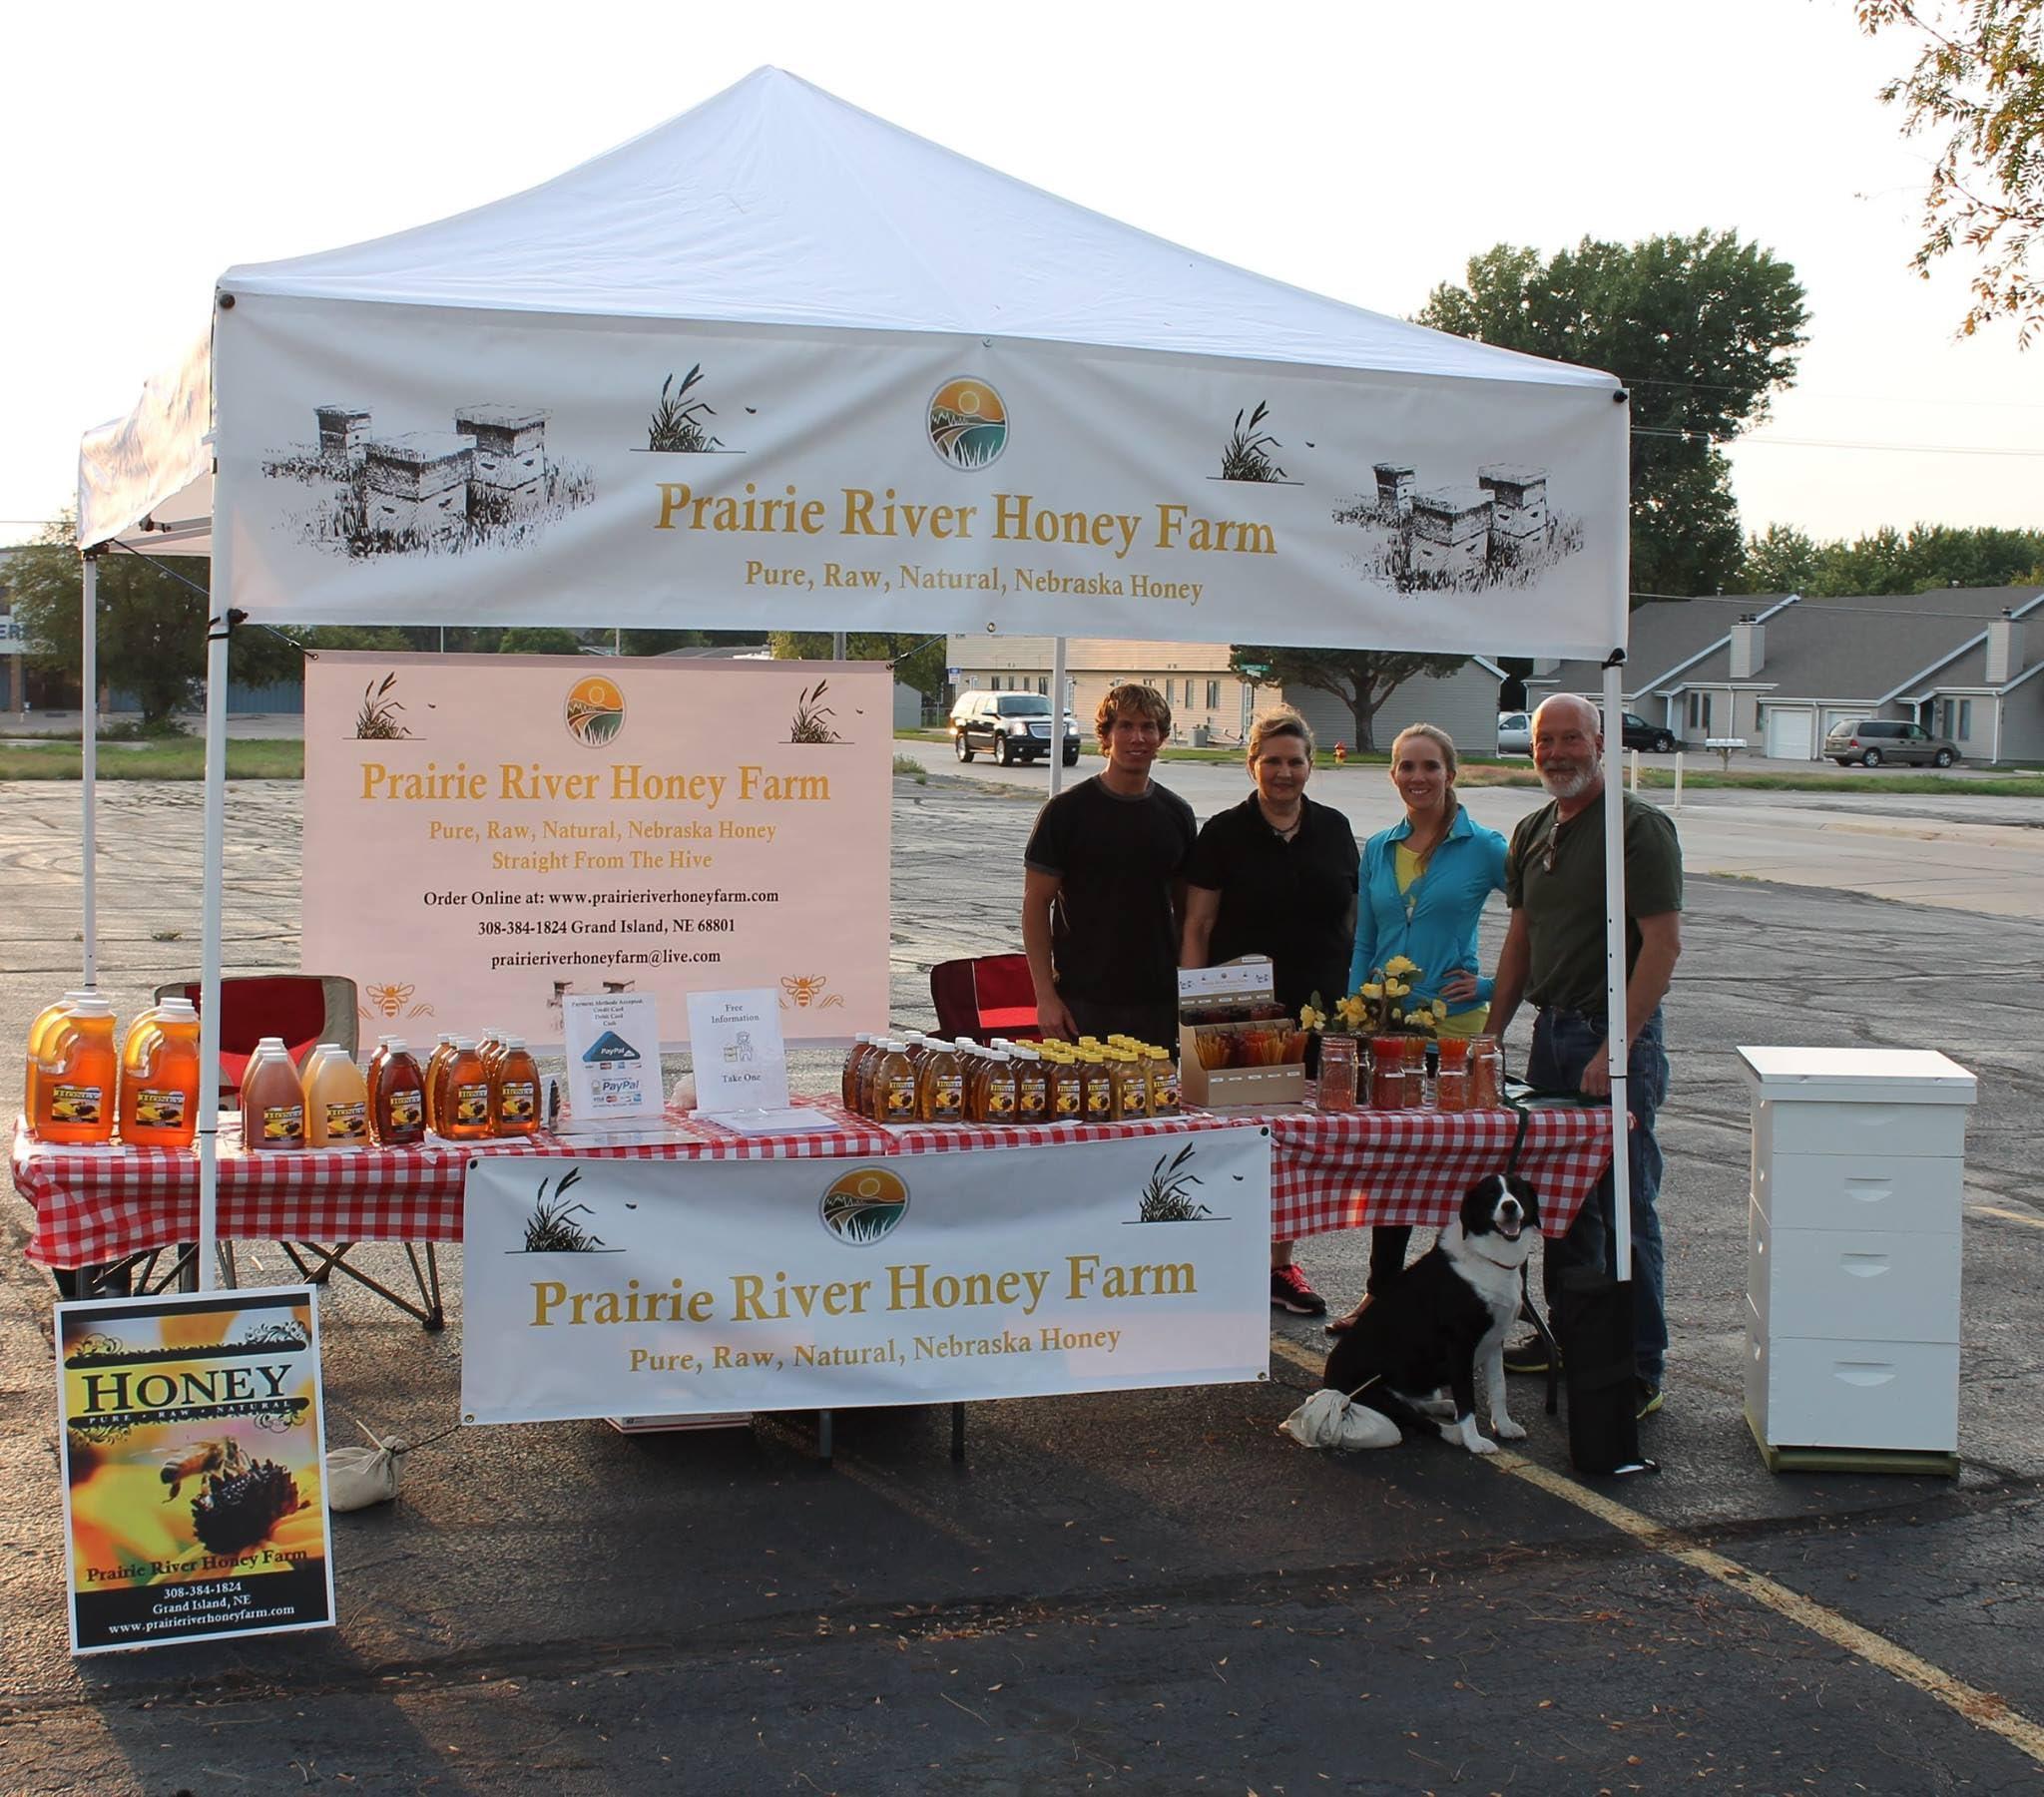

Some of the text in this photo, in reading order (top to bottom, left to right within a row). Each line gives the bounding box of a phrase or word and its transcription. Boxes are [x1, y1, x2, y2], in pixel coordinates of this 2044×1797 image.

[654, 483, 1278, 559] Prairie River Honey Farm
[745, 560, 1204, 606] Pure, Raw, Natural, Nebraska Honey
[360, 763, 831, 809] Prairie River Honey Farm
[429, 820, 776, 843] Pure, Raw, Natural, Nebraska Honey
[492, 851, 713, 873] Straight From The Hive
[423, 889, 779, 907] Order Online at: www.prairieriverhoneyfarm.com
[478, 918, 736, 936] 308-384-1824 Grand Island, NE 68801
[491, 950, 722, 969] prairieriverhoneyfarm@live.com
[712, 1013, 760, 1024] Information
[725, 1004, 744, 1013] Free
[603, 1081, 639, 1092] PayPal
[529, 1253, 1198, 1328] Prairie River Honey Farm
[629, 1327, 1122, 1375] Pure, Raw, Natural, Nebraska Honey
[82, 1364, 293, 1413] HONEY
[89, 1400, 291, 1425] PURE RAW NATURAL
[87, 1549, 307, 1582] Prairie River Honey Farm
[164, 1581, 242, 1599] 308-384-1824
[152, 1594, 252, 1615] Grand Island, NE
[108, 1604, 295, 1633] www.prairieriverhoneyfarm.com
